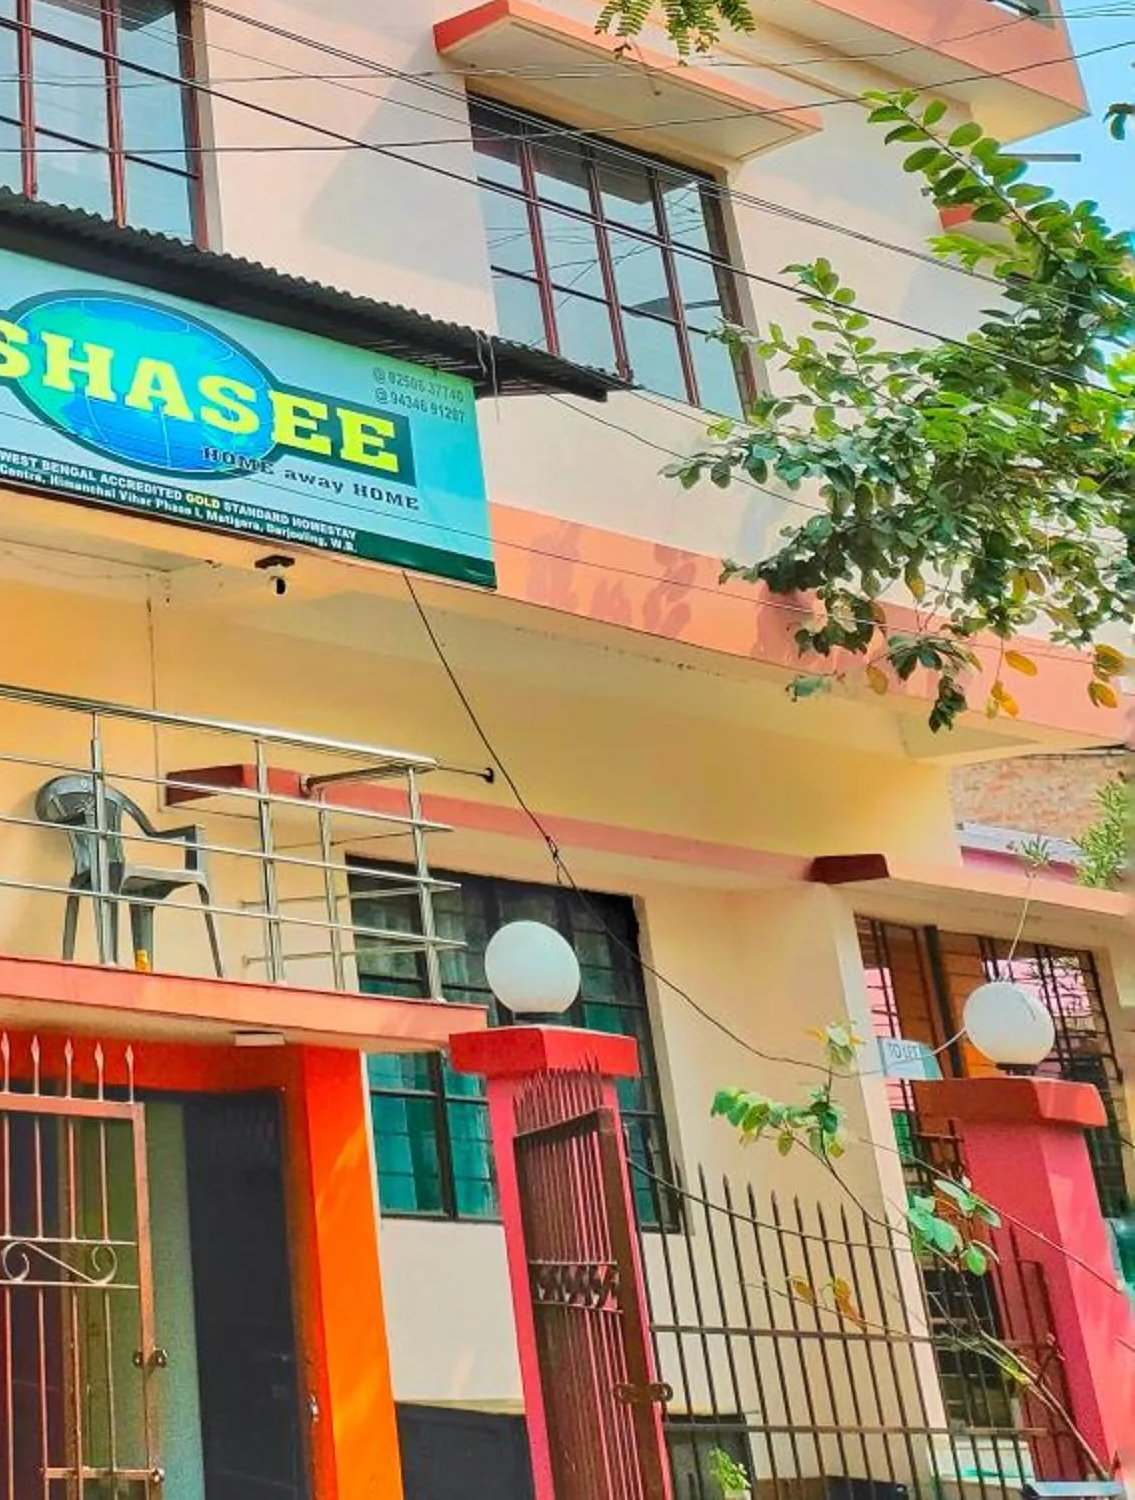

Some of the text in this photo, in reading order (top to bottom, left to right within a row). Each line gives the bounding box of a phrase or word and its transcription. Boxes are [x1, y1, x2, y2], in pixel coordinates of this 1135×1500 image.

[42, 459, 96, 481] BENGAL
[100, 474, 183, 501] ACCREDITED
[185, 492, 221, 509] GOLD
[223, 501, 290, 525] STANDARD
[292, 517, 356, 541] HOMESTAY
[119, 489, 152, 506] Vihar
[202, 445, 420, 511] HOME away HOME
